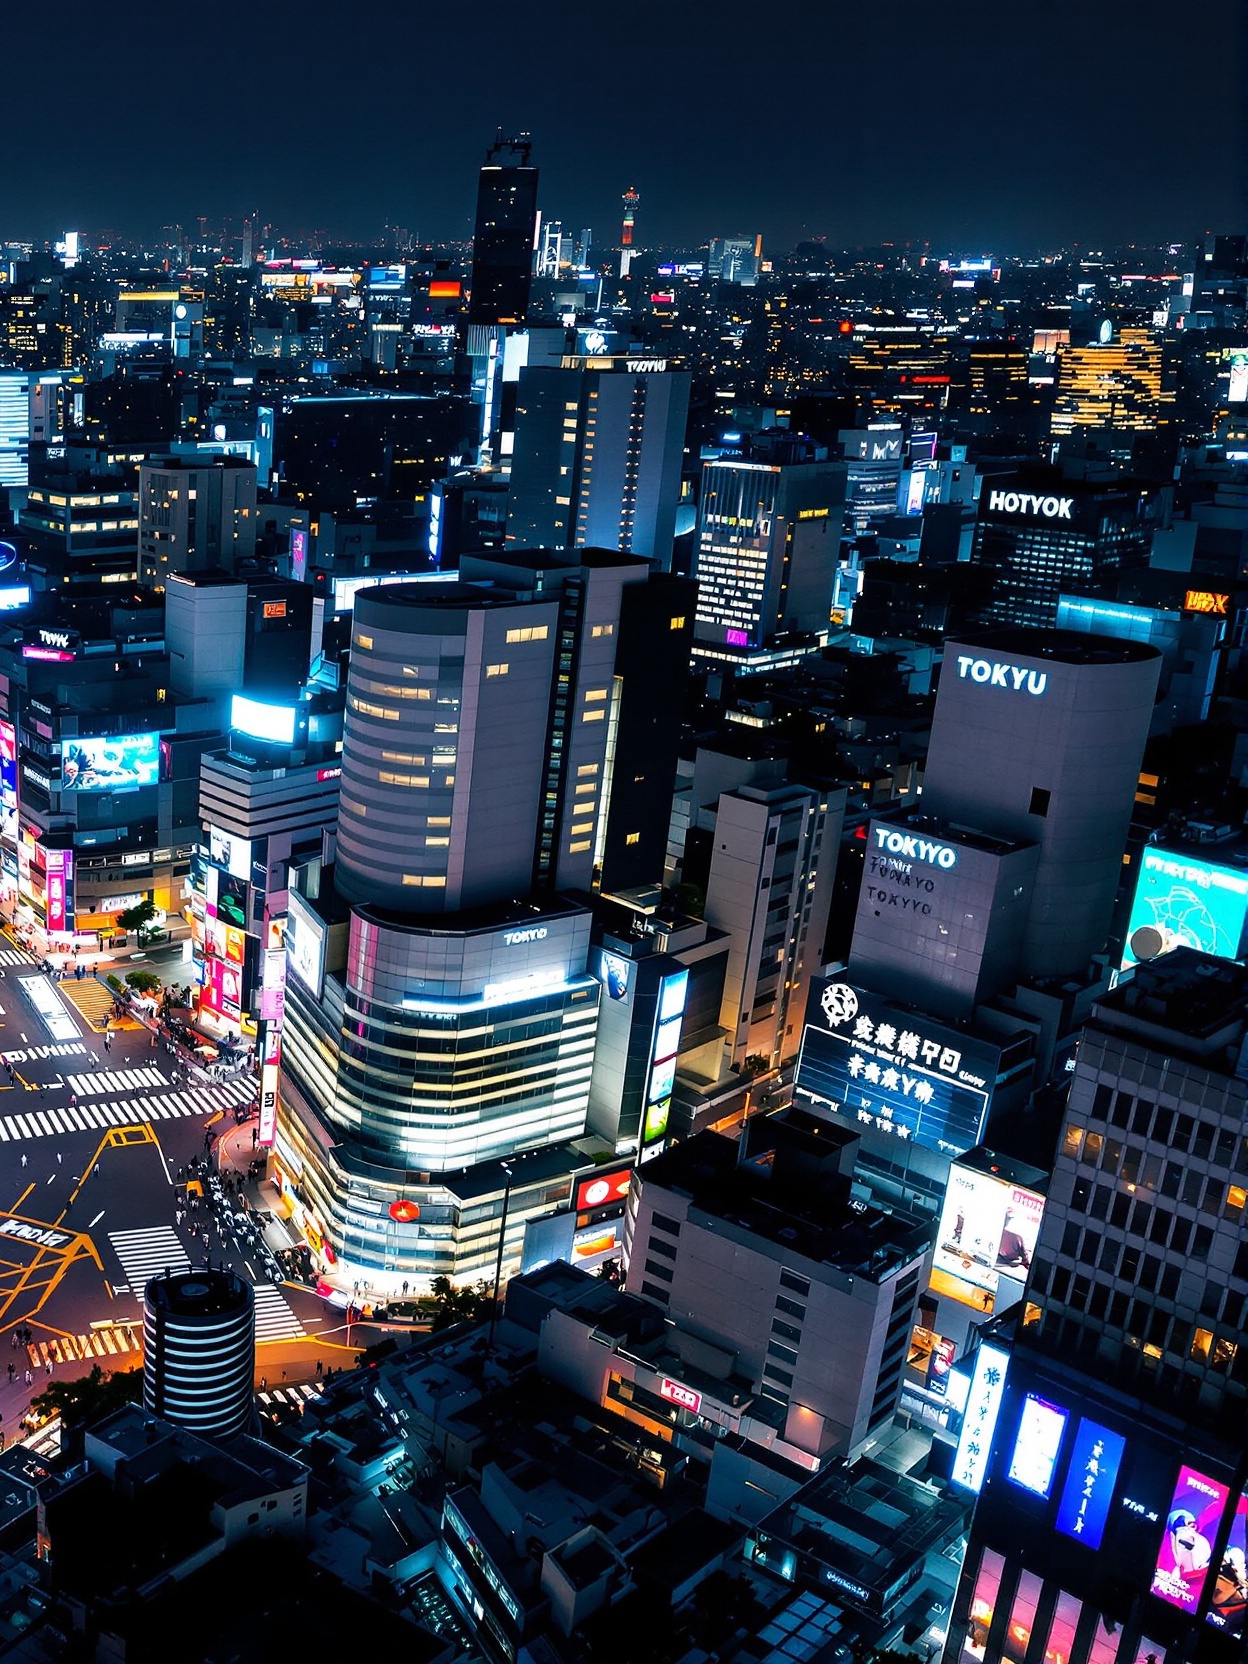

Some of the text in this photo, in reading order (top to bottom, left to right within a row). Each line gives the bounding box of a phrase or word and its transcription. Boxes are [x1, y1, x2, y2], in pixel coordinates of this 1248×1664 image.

[989, 490, 1074, 520] HOTYOK
[957, 655, 1047, 695] TOKYU
[875, 828, 956, 869] TOKYYO
